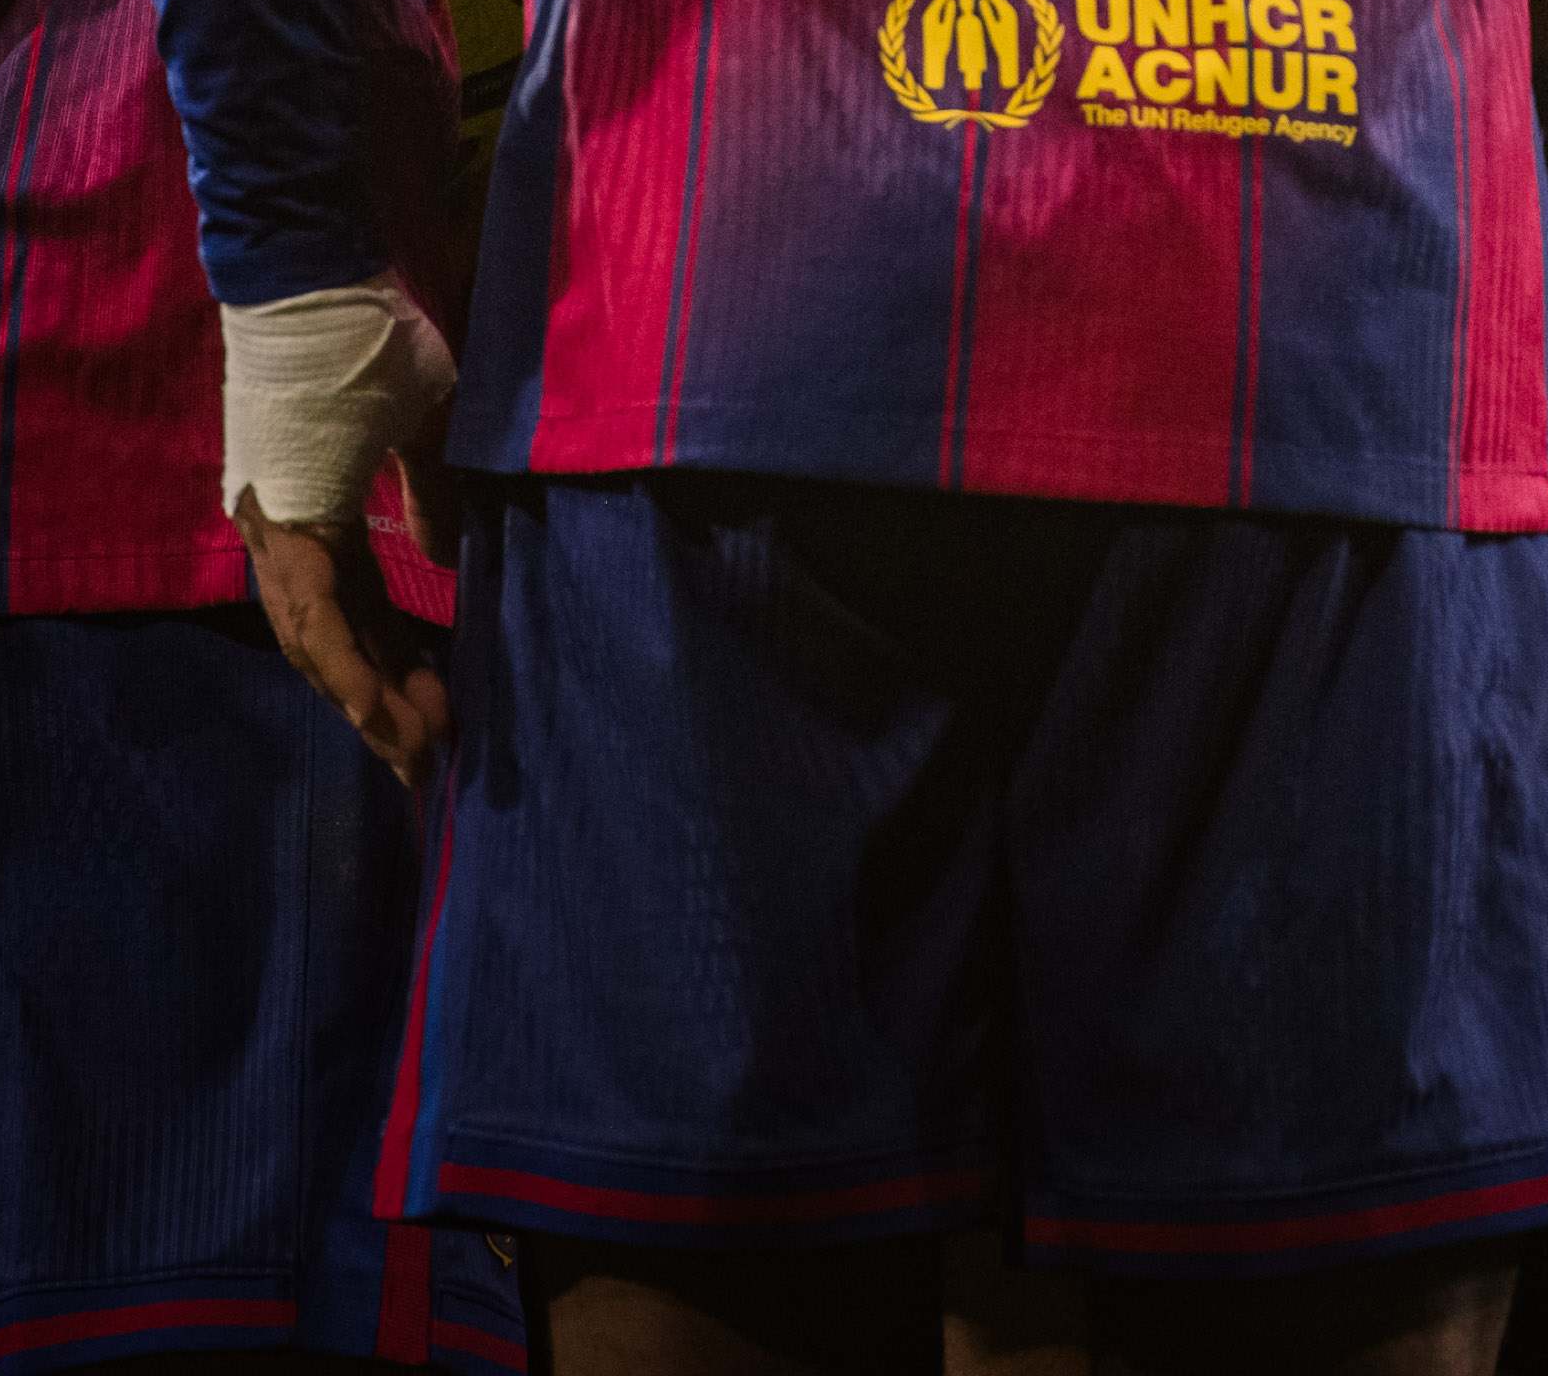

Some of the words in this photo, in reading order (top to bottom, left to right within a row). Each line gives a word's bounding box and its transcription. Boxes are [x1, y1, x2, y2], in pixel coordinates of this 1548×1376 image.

[1076, 45, 1359, 116] ACNUR
[1080, 103, 1128, 127] The
[1130, 105, 1170, 130] UN
[1172, 108, 1272, 139] Refugee
[1274, 114, 1358, 148] Agency
